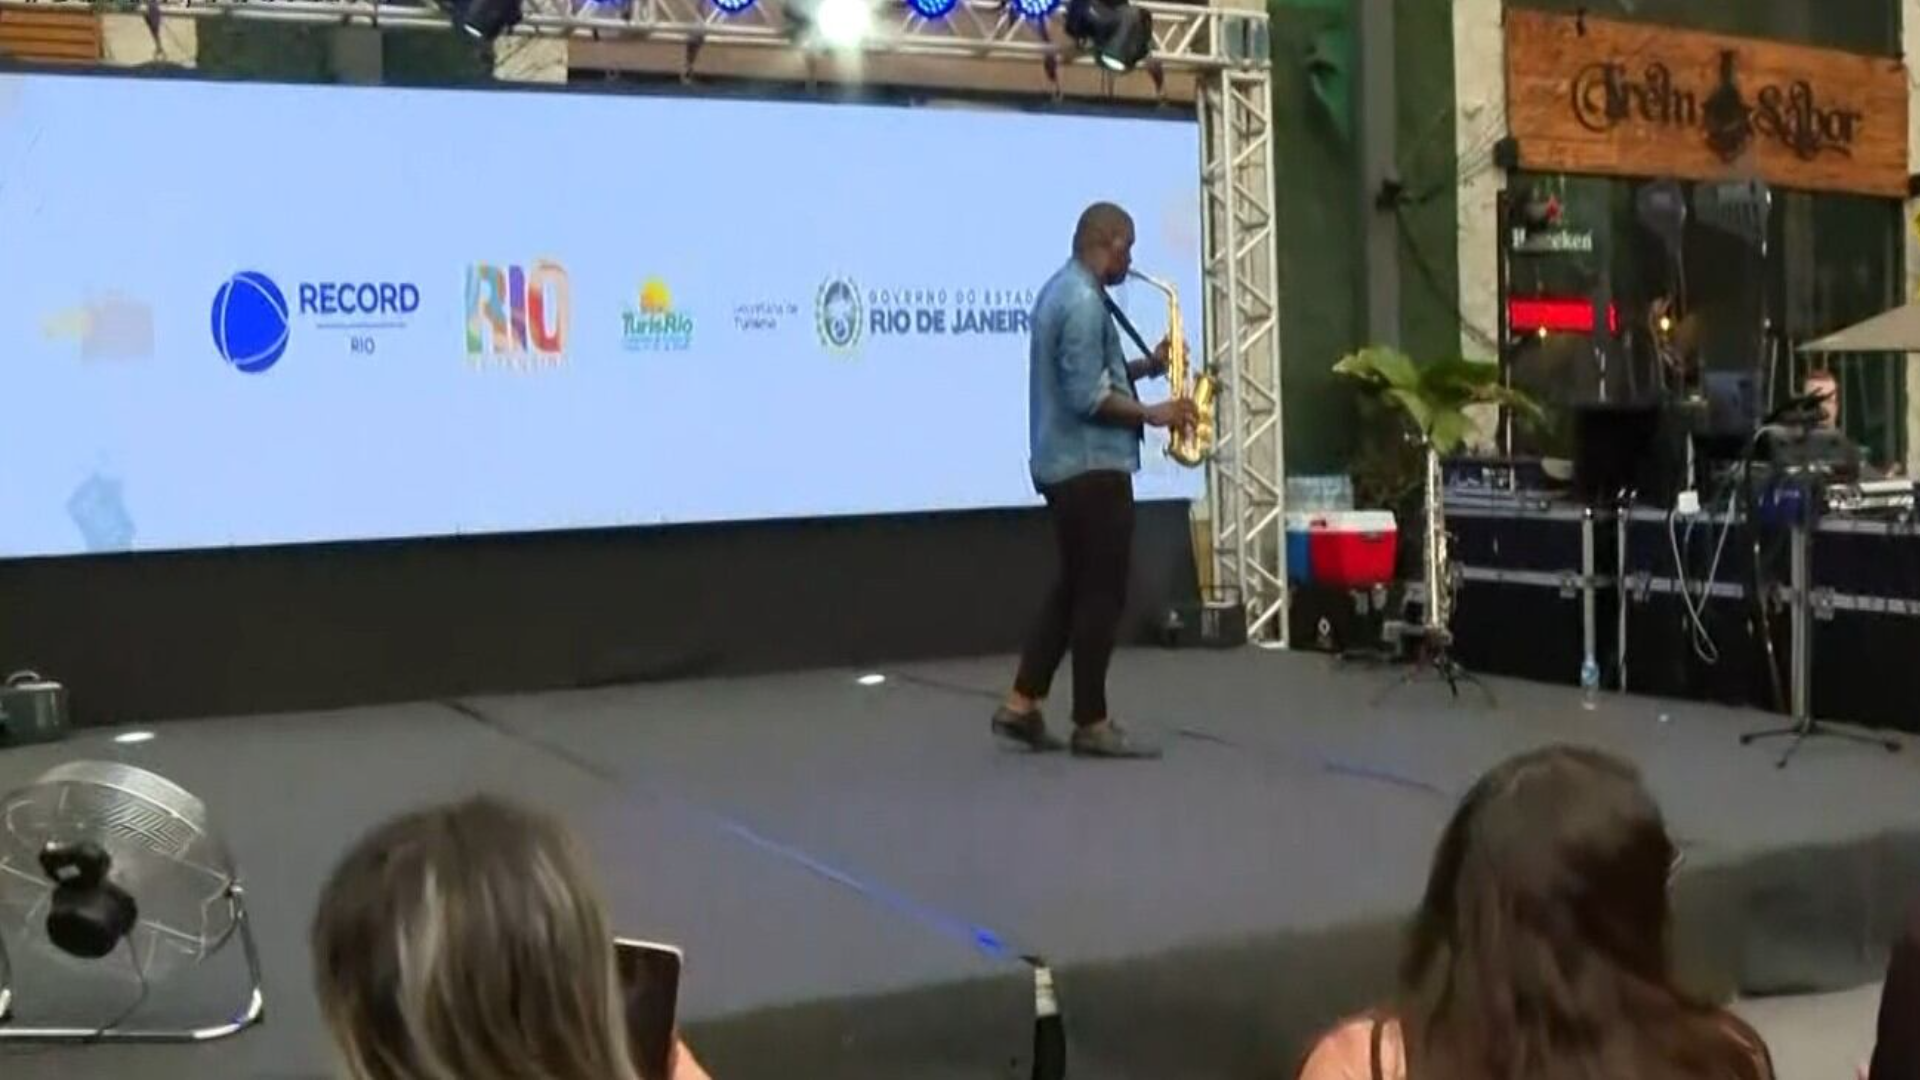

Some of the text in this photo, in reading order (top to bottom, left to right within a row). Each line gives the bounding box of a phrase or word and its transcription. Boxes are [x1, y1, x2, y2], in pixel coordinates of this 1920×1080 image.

[1512, 227, 1592, 251] Heken
[298, 282, 420, 315] RECORD
[465, 258, 569, 353] RIO
[868, 288, 1035, 306] GOVERNO DO ESTAD
[869, 308, 1034, 334] RIO DE JANEIR
[350, 336, 376, 355] RIO
